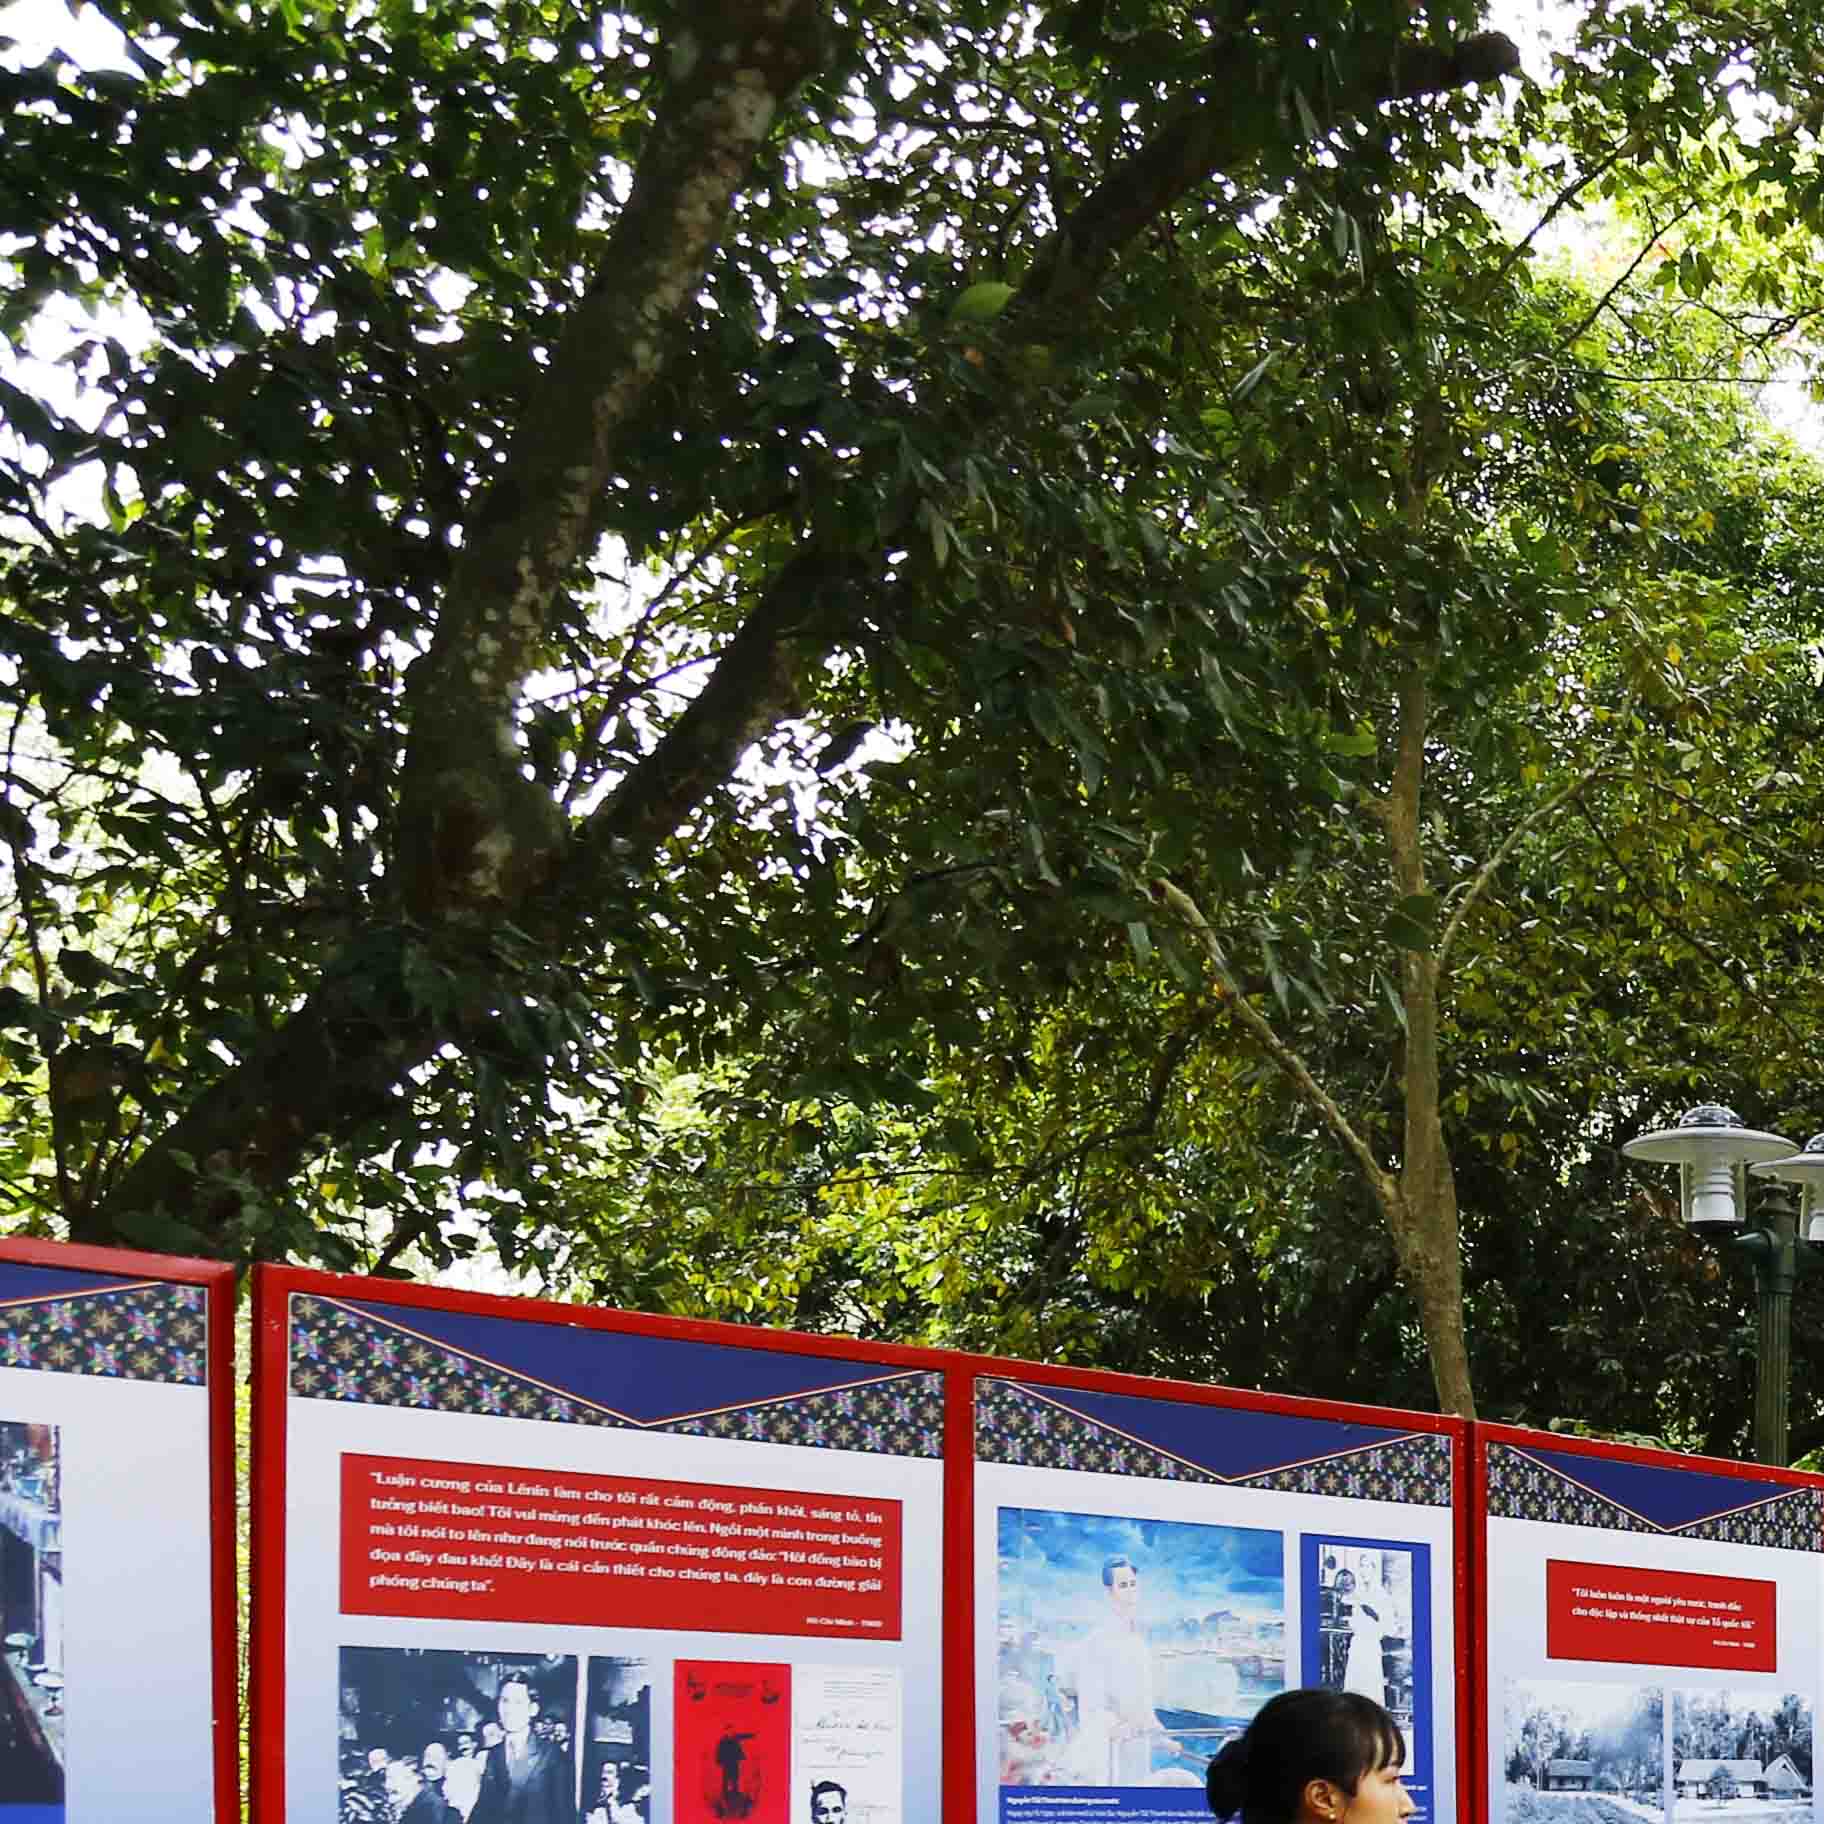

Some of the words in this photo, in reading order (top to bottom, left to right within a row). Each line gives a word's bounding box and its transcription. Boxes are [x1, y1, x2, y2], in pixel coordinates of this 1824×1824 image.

[475, 1480, 503, 1493] của
[585, 1490, 613, 1502] cho
[617, 1492, 636, 1503] tôi
[866, 1512, 882, 1523] tin
[421, 1527, 447, 1538] nói
[449, 1529, 465, 1540] to
[488, 1506, 512, 1518] Tôi
[514, 1509, 536, 1520] vui
[806, 1531, 840, 1544] trong
[648, 1567, 675, 1578] cho
[787, 1577, 812, 1586] con
